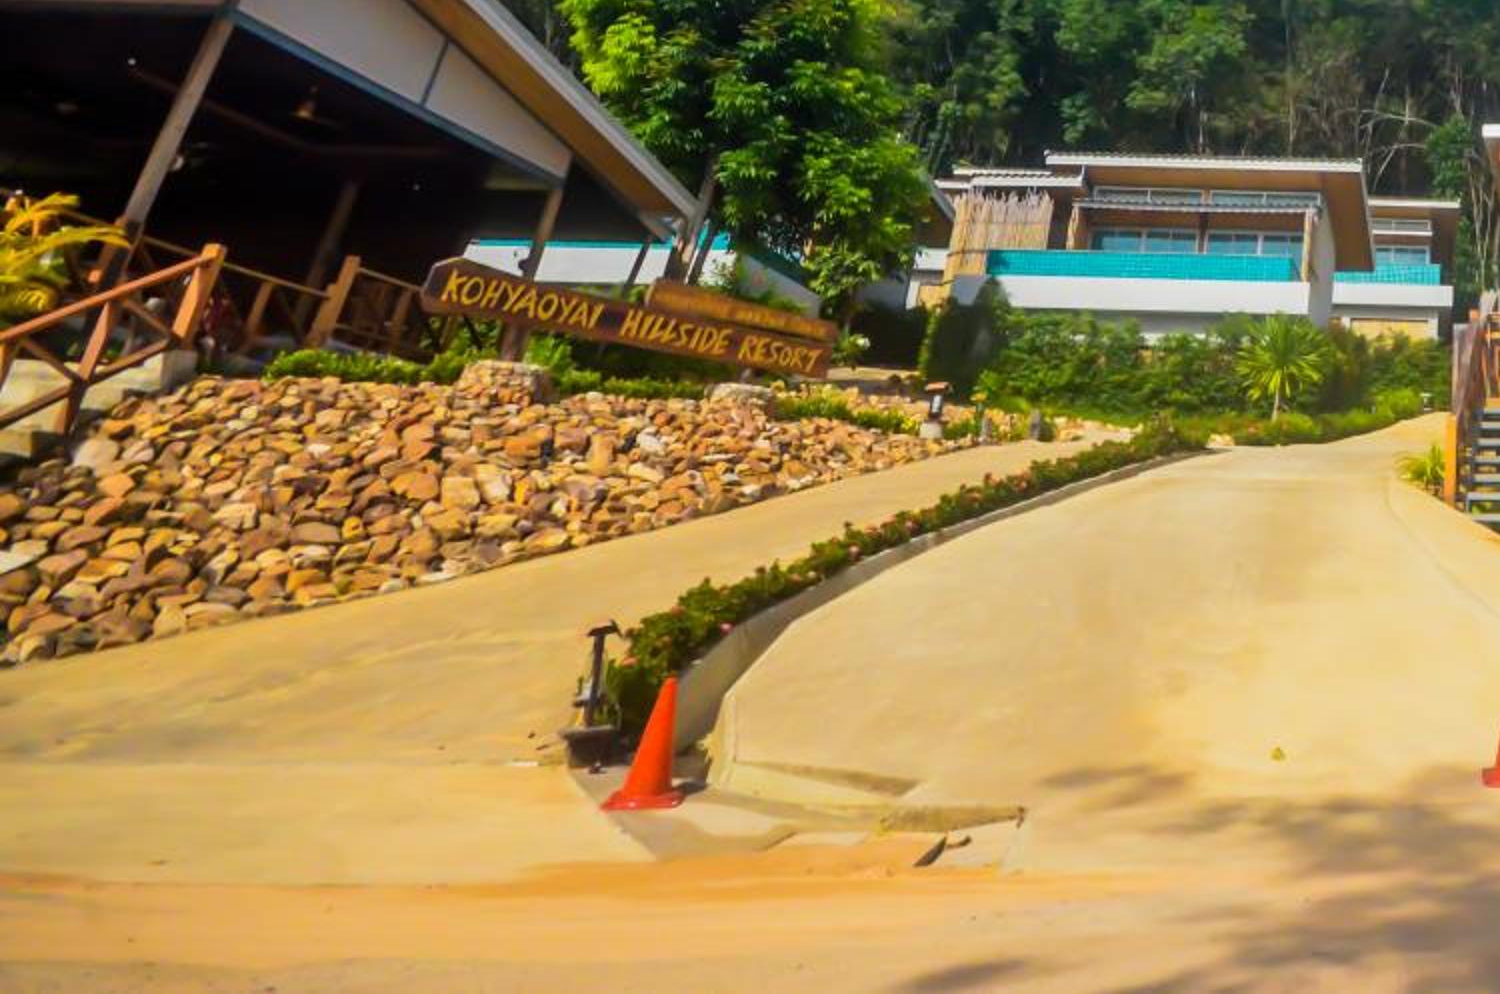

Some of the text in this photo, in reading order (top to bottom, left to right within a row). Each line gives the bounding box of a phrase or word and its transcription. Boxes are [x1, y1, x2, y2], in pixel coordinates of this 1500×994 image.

[441, 270, 604, 328] KOHYAOYAI
[619, 310, 731, 355] HILLSIDE
[737, 337, 822, 370] RESORT
